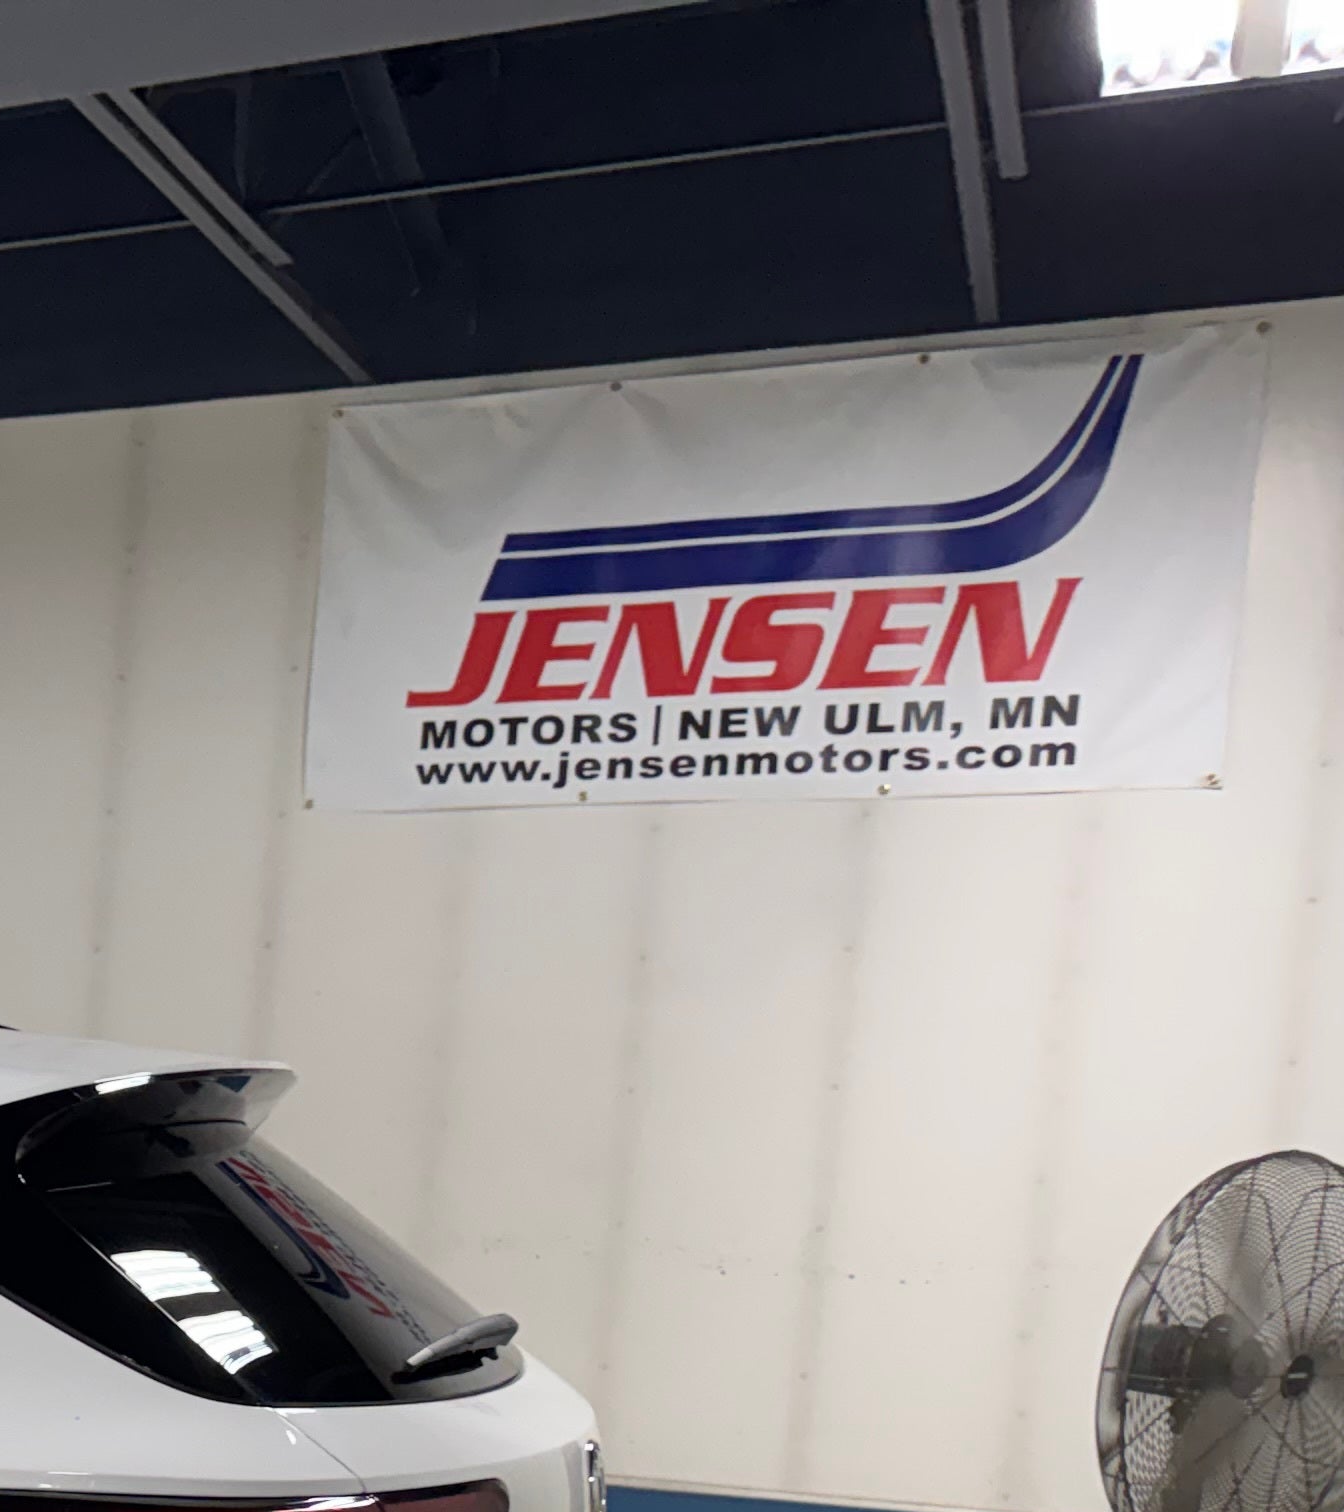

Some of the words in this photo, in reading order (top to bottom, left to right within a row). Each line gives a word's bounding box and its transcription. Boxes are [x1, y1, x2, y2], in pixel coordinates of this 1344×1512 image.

[405, 576, 1083, 709] JENSEN
[418, 713, 638, 750] MOTORS
[678, 706, 801, 741] NEW
[825, 701, 965, 738] ULM,
[989, 695, 1079, 730] MN
[415, 742, 1077, 789] www.jensenmotors.com
